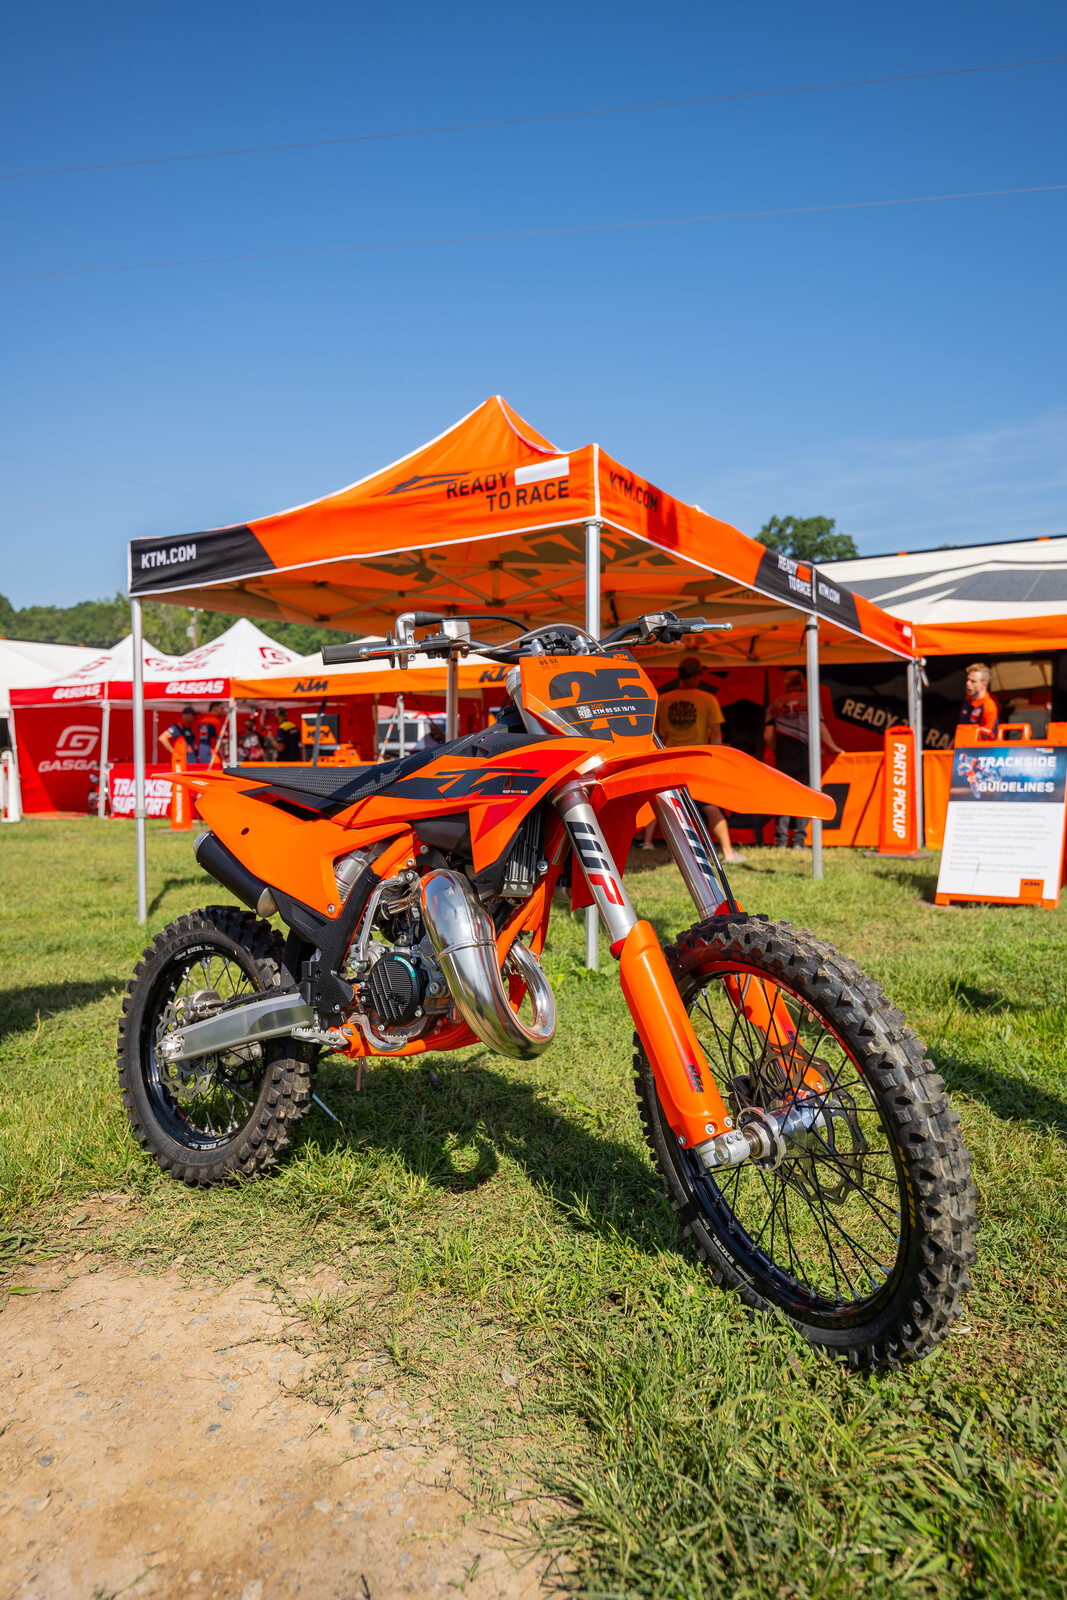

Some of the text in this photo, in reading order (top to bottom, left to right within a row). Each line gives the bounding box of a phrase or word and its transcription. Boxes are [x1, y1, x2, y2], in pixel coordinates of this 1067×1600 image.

[446, 471, 510, 499] READY
[486, 479, 570, 512] TO RACE
[609, 471, 658, 513] KTM.COM
[141, 544, 197, 569] KTM.COM
[778, 555, 798, 576] READY
[293, 678, 329, 693] KTM
[479, 665, 508, 683] KT
[52, 684, 101, 700] GASGAS
[165, 680, 225, 694] GASGAS
[549, 669, 654, 741] 25
[842, 699, 898, 729] READY
[38, 759, 100, 773] GASGA
[893, 742, 907, 786] PARTS
[978, 756, 1057, 768] TRACKSIDE
[979, 782, 1055, 793] GUIDELINES
[112, 797, 172, 816] SUPORT
[892, 788, 906, 839] PICKUP
[712, 1233, 735, 1264] EXCEL
